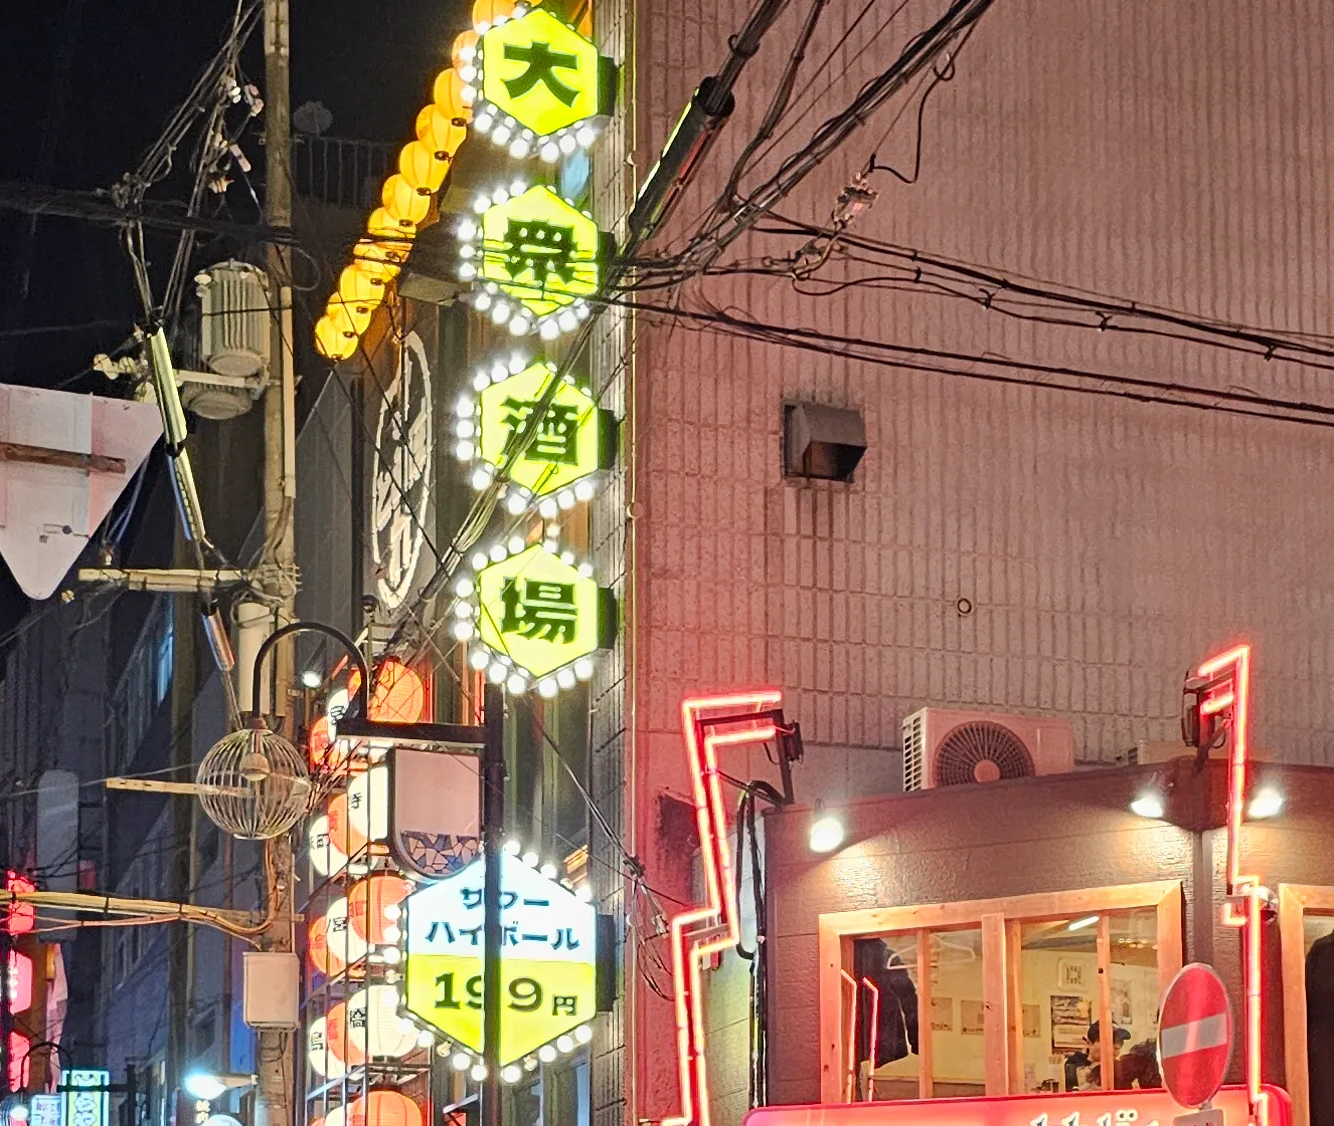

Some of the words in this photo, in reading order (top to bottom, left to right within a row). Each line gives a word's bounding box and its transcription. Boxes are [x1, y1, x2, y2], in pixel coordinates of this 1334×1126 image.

[502, 42, 580, 644] 大衆酒場
[425, 920, 580, 950] ハイボール
